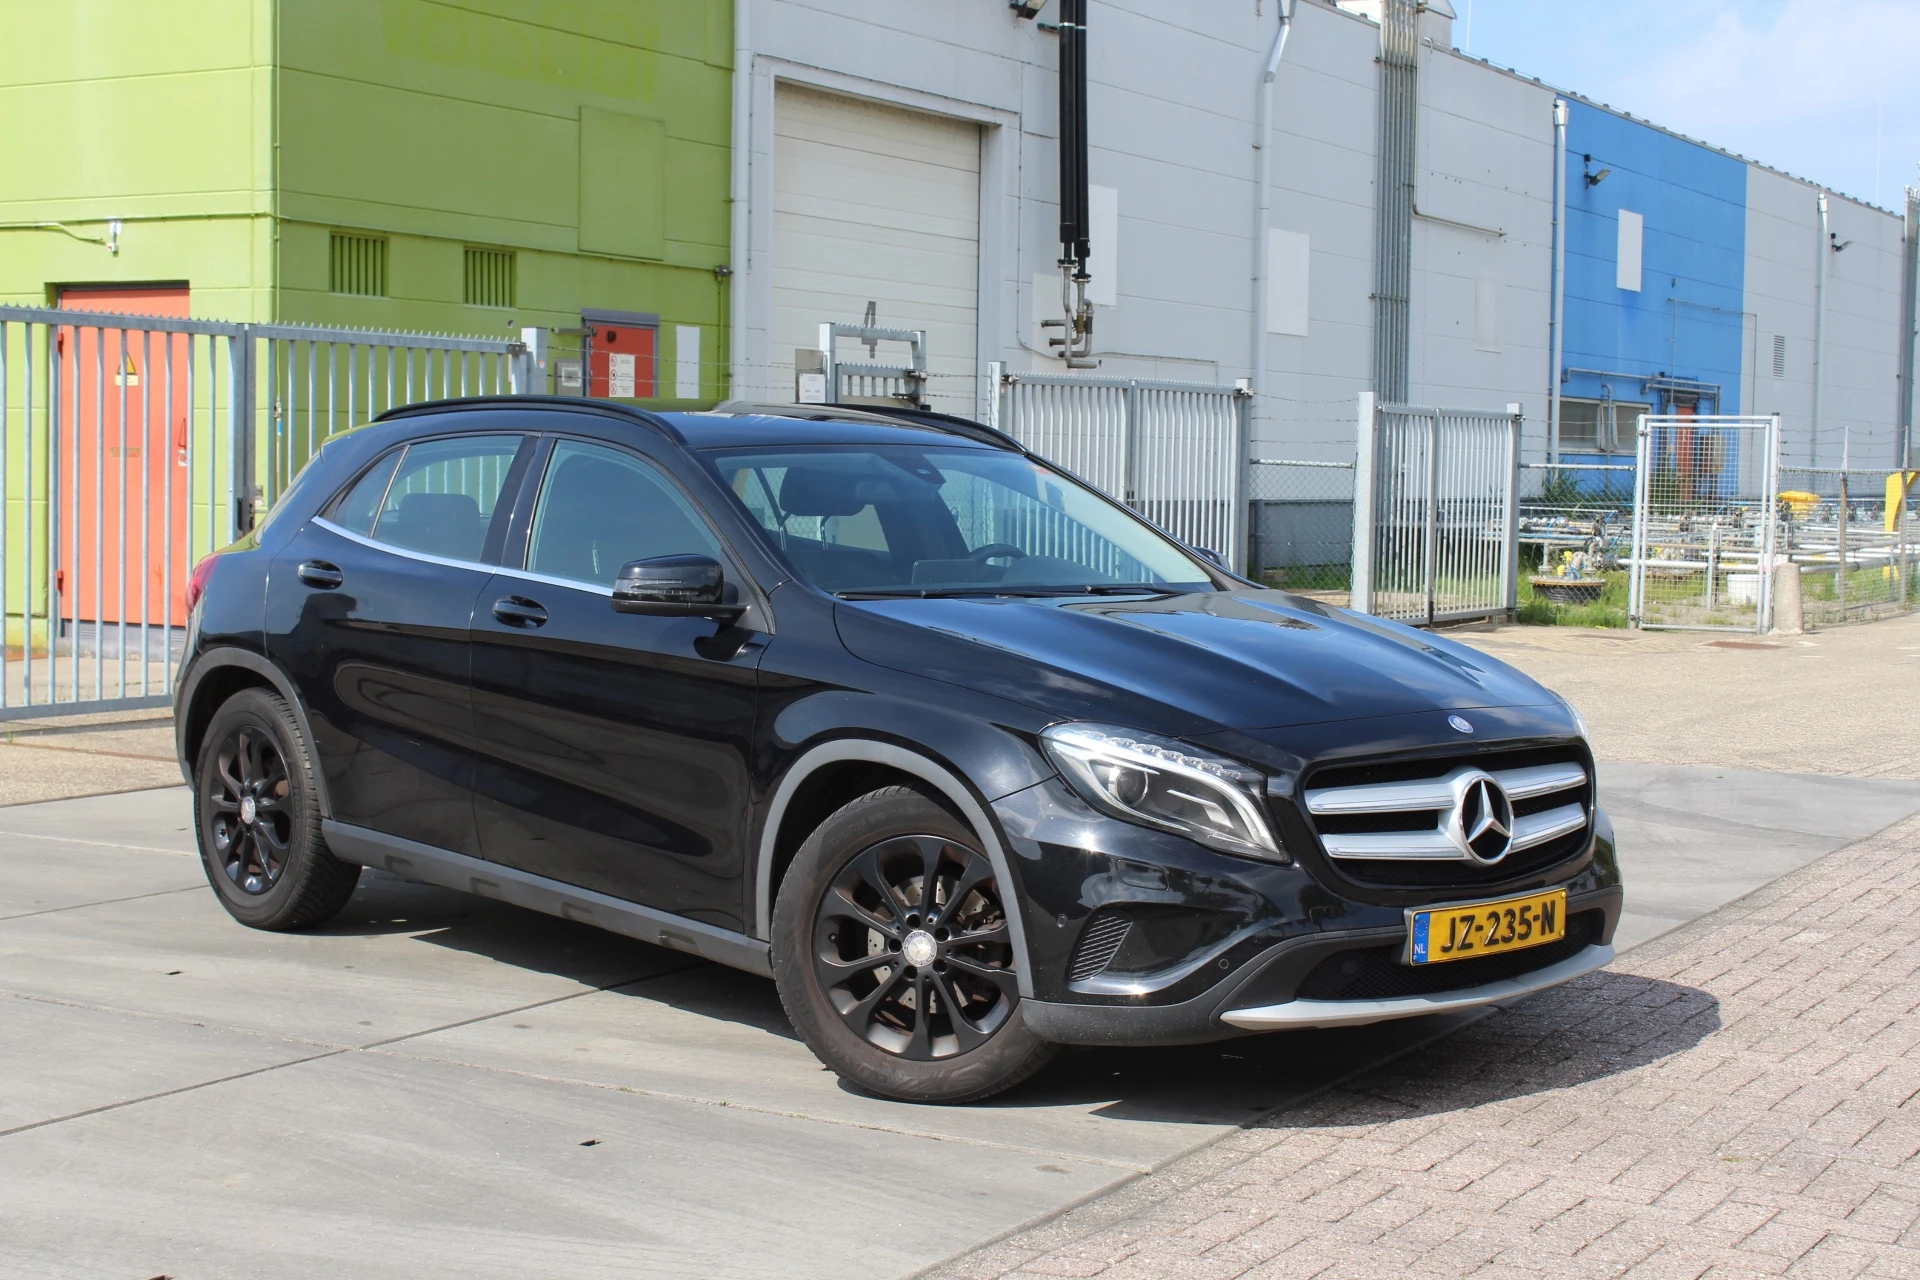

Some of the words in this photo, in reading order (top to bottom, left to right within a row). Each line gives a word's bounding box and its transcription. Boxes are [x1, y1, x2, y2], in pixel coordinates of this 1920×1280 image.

[861, 301, 877, 359] 4
[1414, 943, 1426, 955] NL
[1440, 900, 1556, 953] JZ-235-N
